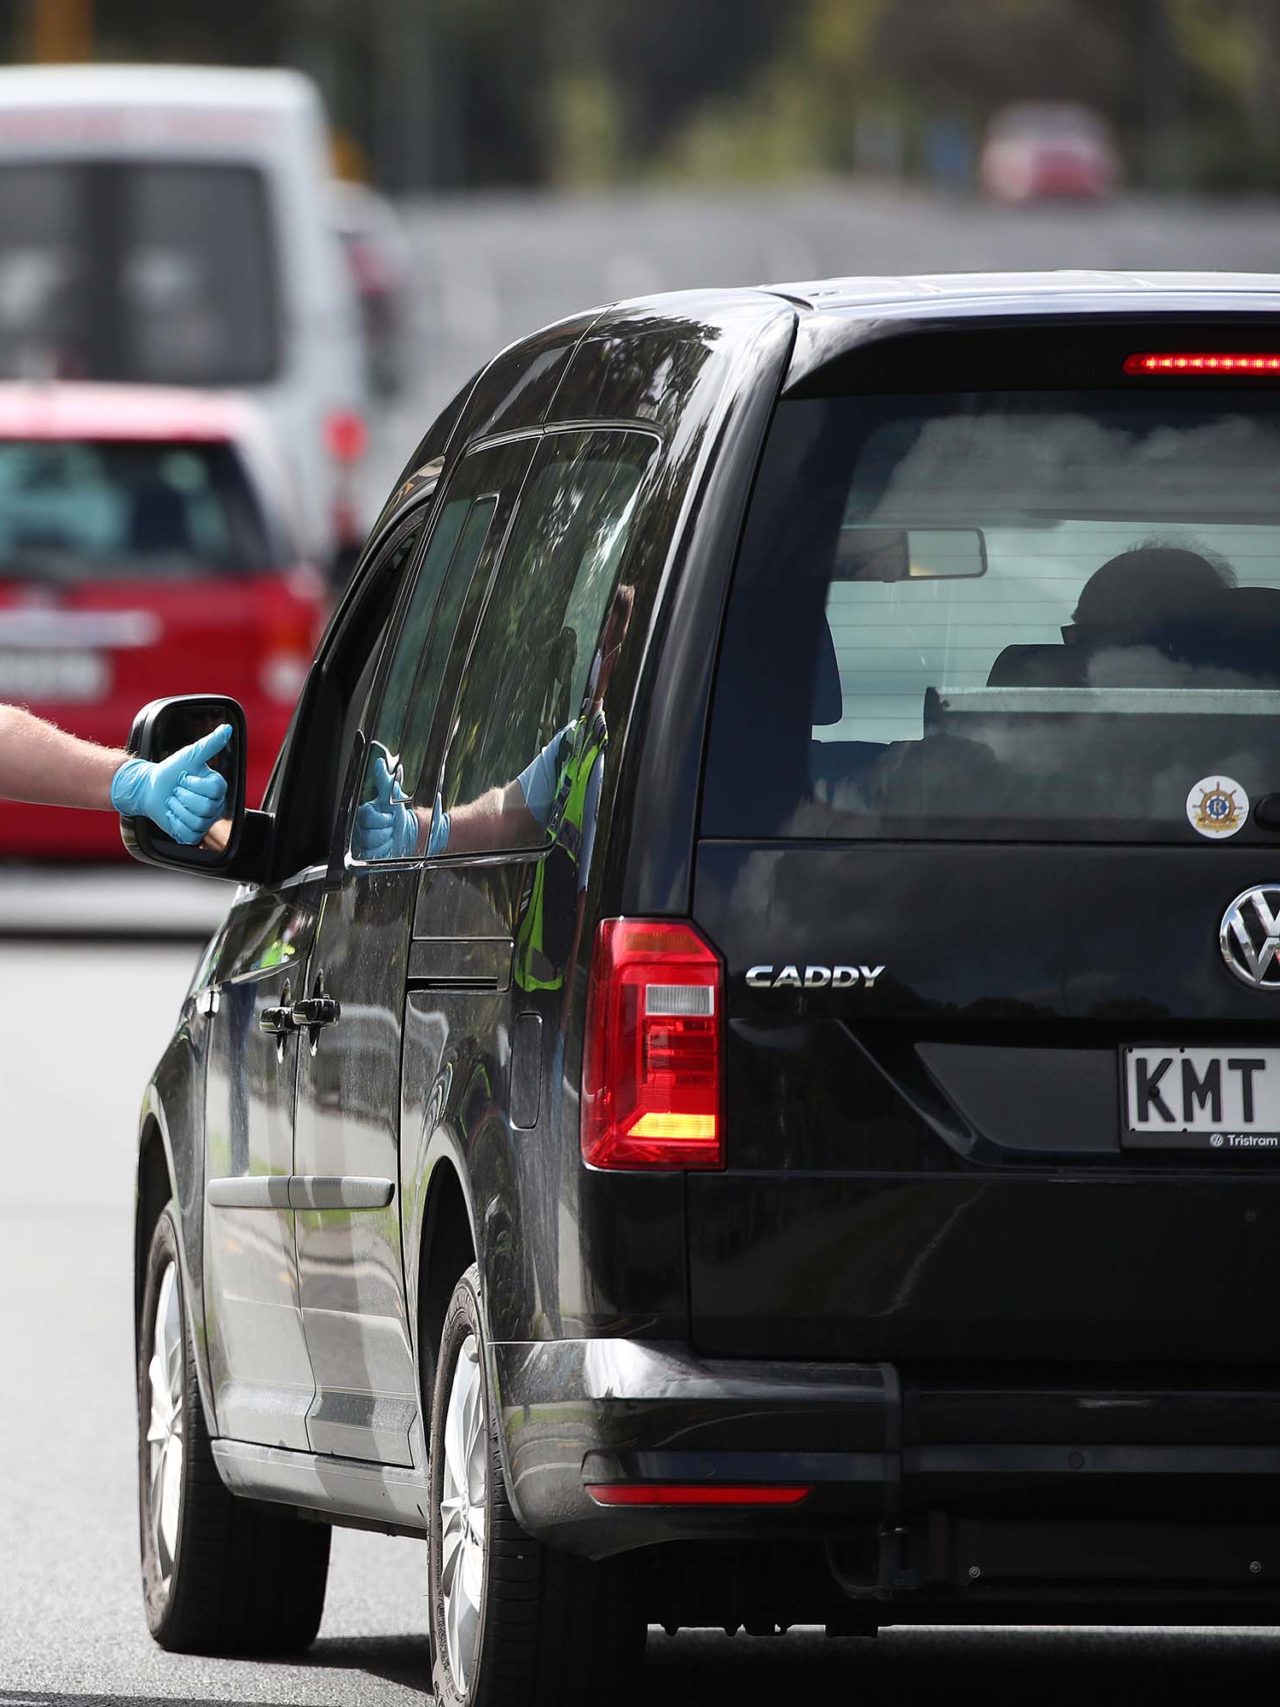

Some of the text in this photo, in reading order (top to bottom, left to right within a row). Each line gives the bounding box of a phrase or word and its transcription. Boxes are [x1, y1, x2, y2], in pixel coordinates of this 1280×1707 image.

[1213, 801, 1223, 814] R
[745, 965, 886, 988] CADDY
[1135, 1058, 1266, 1123] KMT
[1227, 1134, 1278, 1146] Tristram
